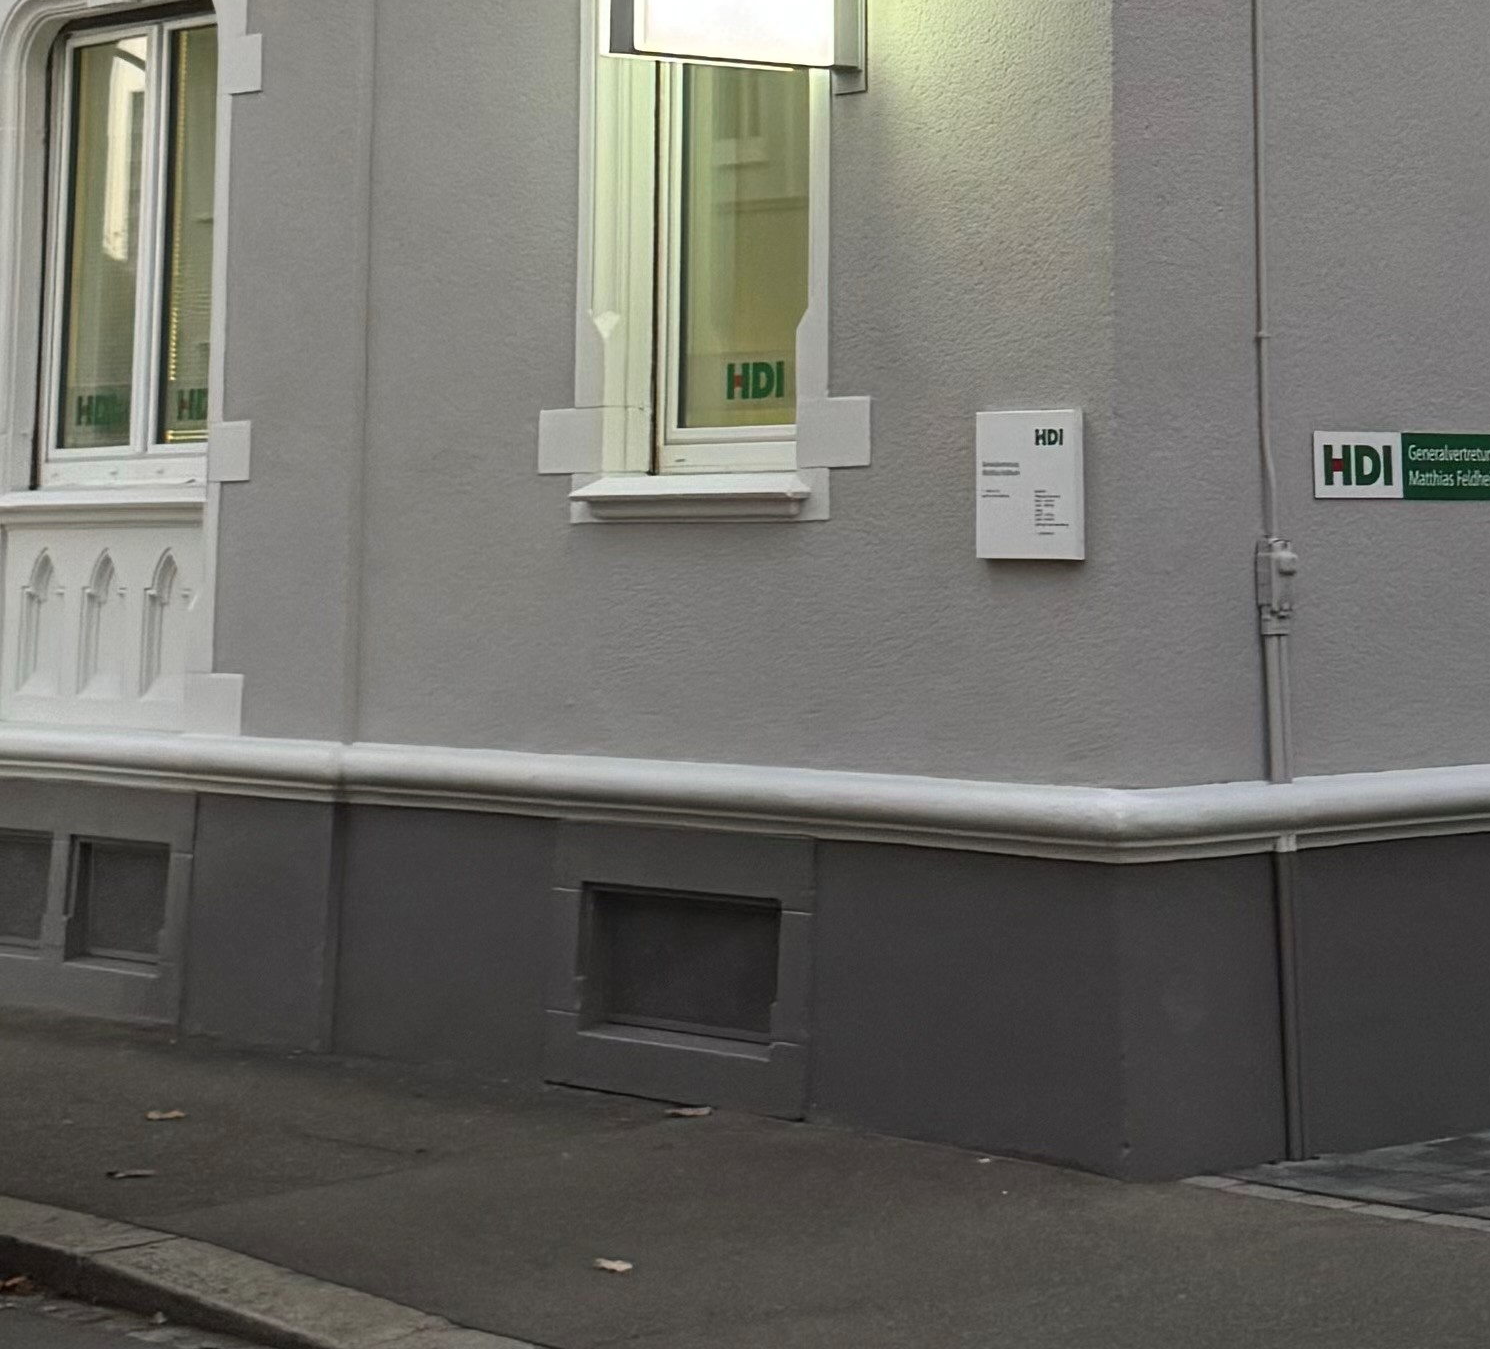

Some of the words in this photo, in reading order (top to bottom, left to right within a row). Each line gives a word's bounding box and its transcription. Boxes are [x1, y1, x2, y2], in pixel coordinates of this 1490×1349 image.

[726, 360, 785, 400] HDI
[1034, 428, 1064, 446] HDI
[1323, 444, 1394, 487] HDI
[1408, 469, 1454, 487] Matthias
